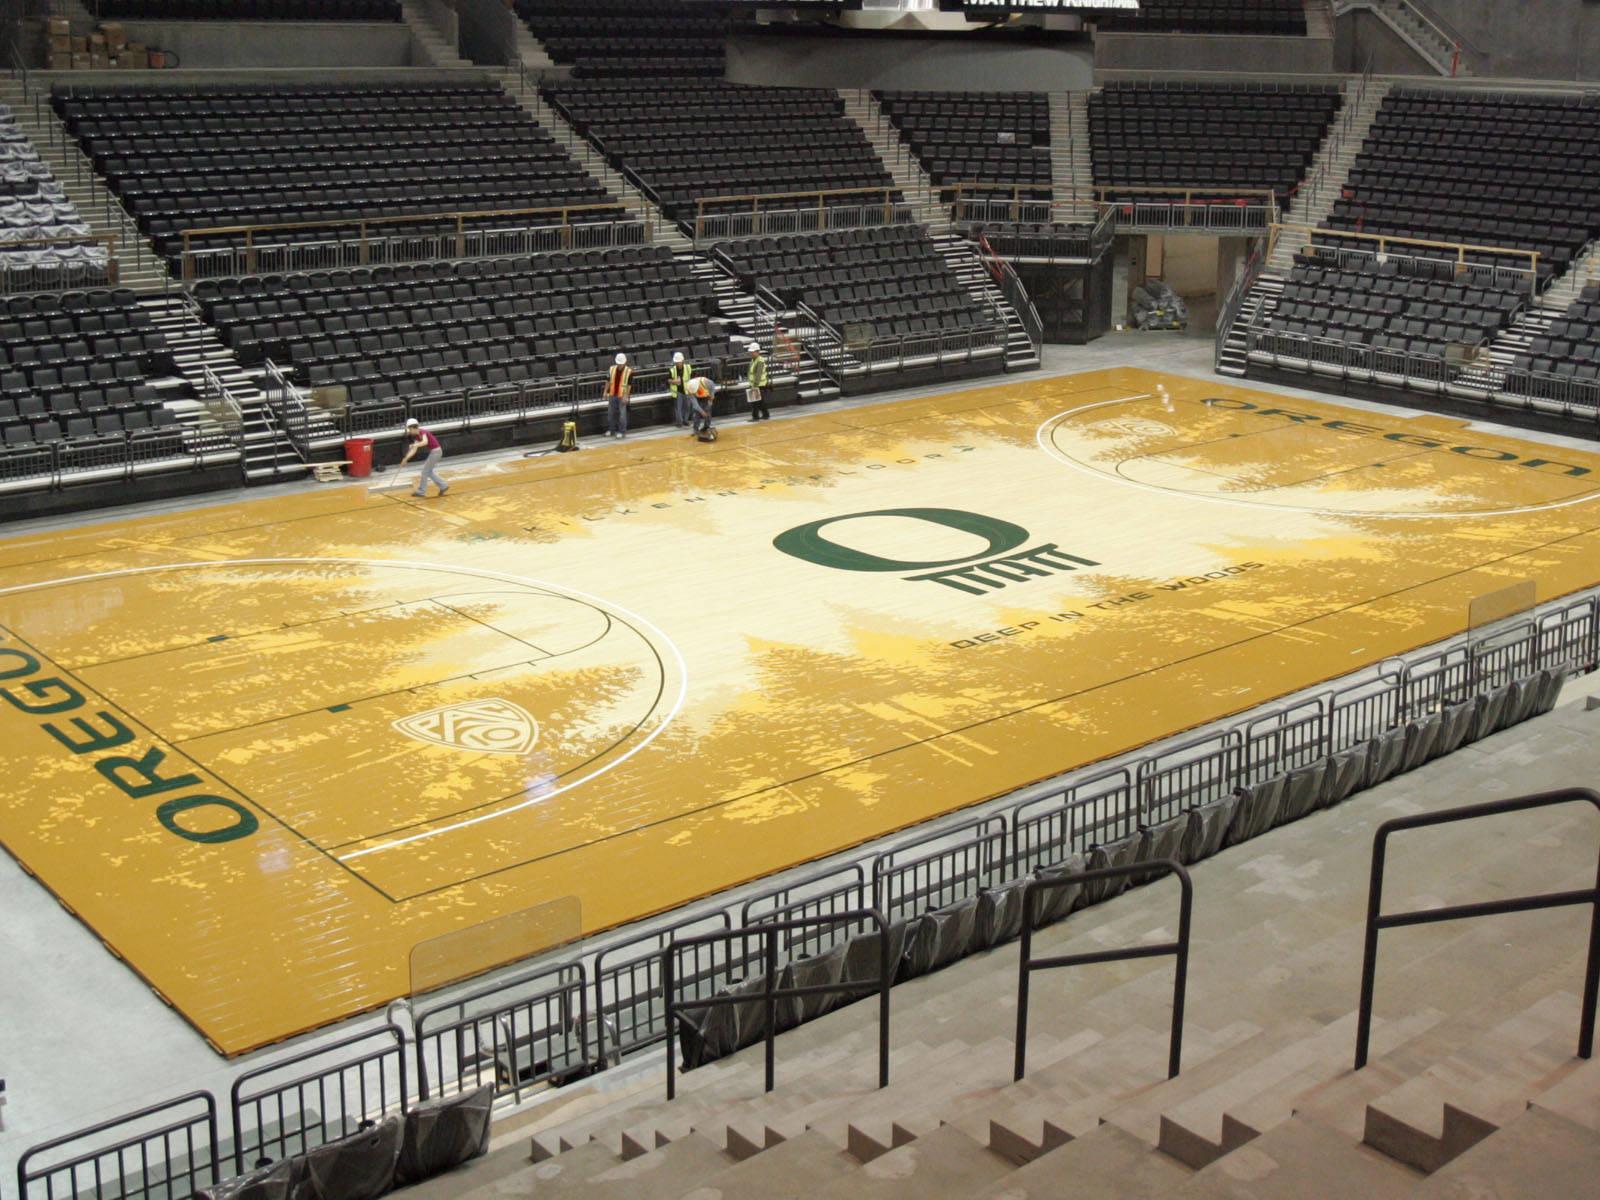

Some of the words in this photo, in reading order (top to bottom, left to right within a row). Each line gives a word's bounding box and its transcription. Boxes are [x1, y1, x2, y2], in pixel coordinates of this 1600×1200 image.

[1200, 398, 1592, 477] OREGON
[949, 620, 1041, 650] DEEP
[1048, 609, 1085, 624] IN
[1086, 591, 1154, 611] THE
[1156, 561, 1265, 592] WOODS
[0, 636, 259, 844] OREG
